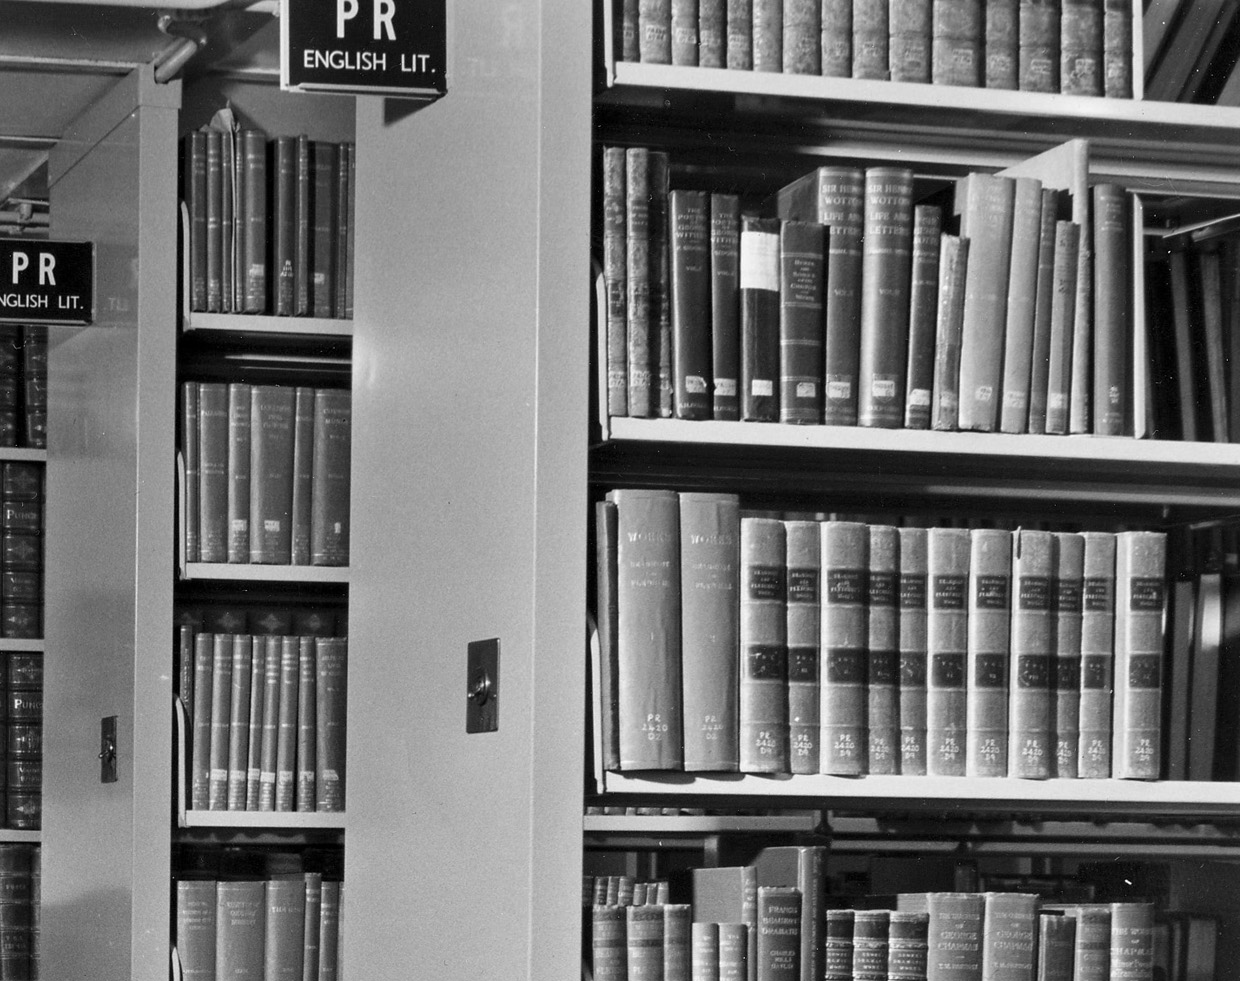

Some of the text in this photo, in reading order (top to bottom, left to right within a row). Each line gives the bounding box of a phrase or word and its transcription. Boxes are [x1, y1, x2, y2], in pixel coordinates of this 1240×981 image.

[304, 50, 436, 73] ENGLISH LIT.
[840, 185, 862, 193] HEN
[825, 197, 862, 205] WOTTO
[58, 295, 84, 309] LIT.
[14, 699, 42, 709] PUNC
